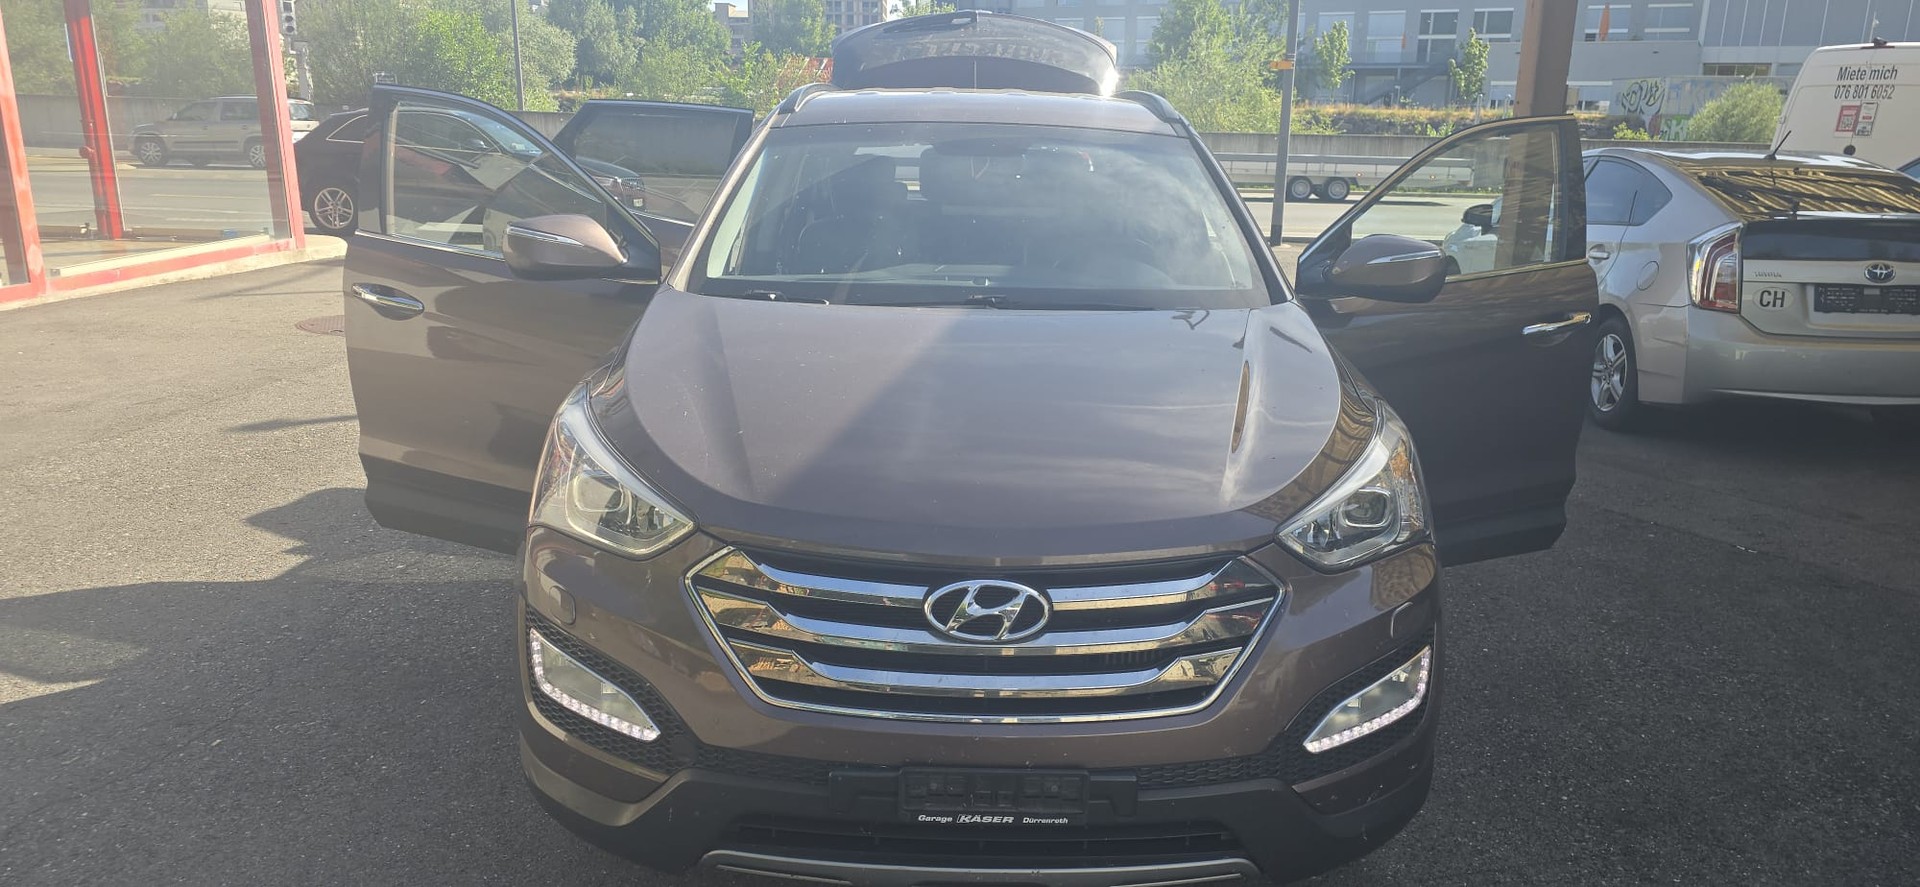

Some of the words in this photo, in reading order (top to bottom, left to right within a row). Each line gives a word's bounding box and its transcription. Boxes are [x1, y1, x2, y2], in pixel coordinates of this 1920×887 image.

[1837, 66, 1866, 81] Miete
[1869, 65, 1897, 80] mich
[1834, 84, 1851, 99] 076
[1853, 84, 1869, 99] 801
[1871, 84, 1895, 100] 6052
[1759, 290, 1785, 308] CH
[918, 814, 953, 823] Garage
[957, 814, 1014, 823] KÄSER
